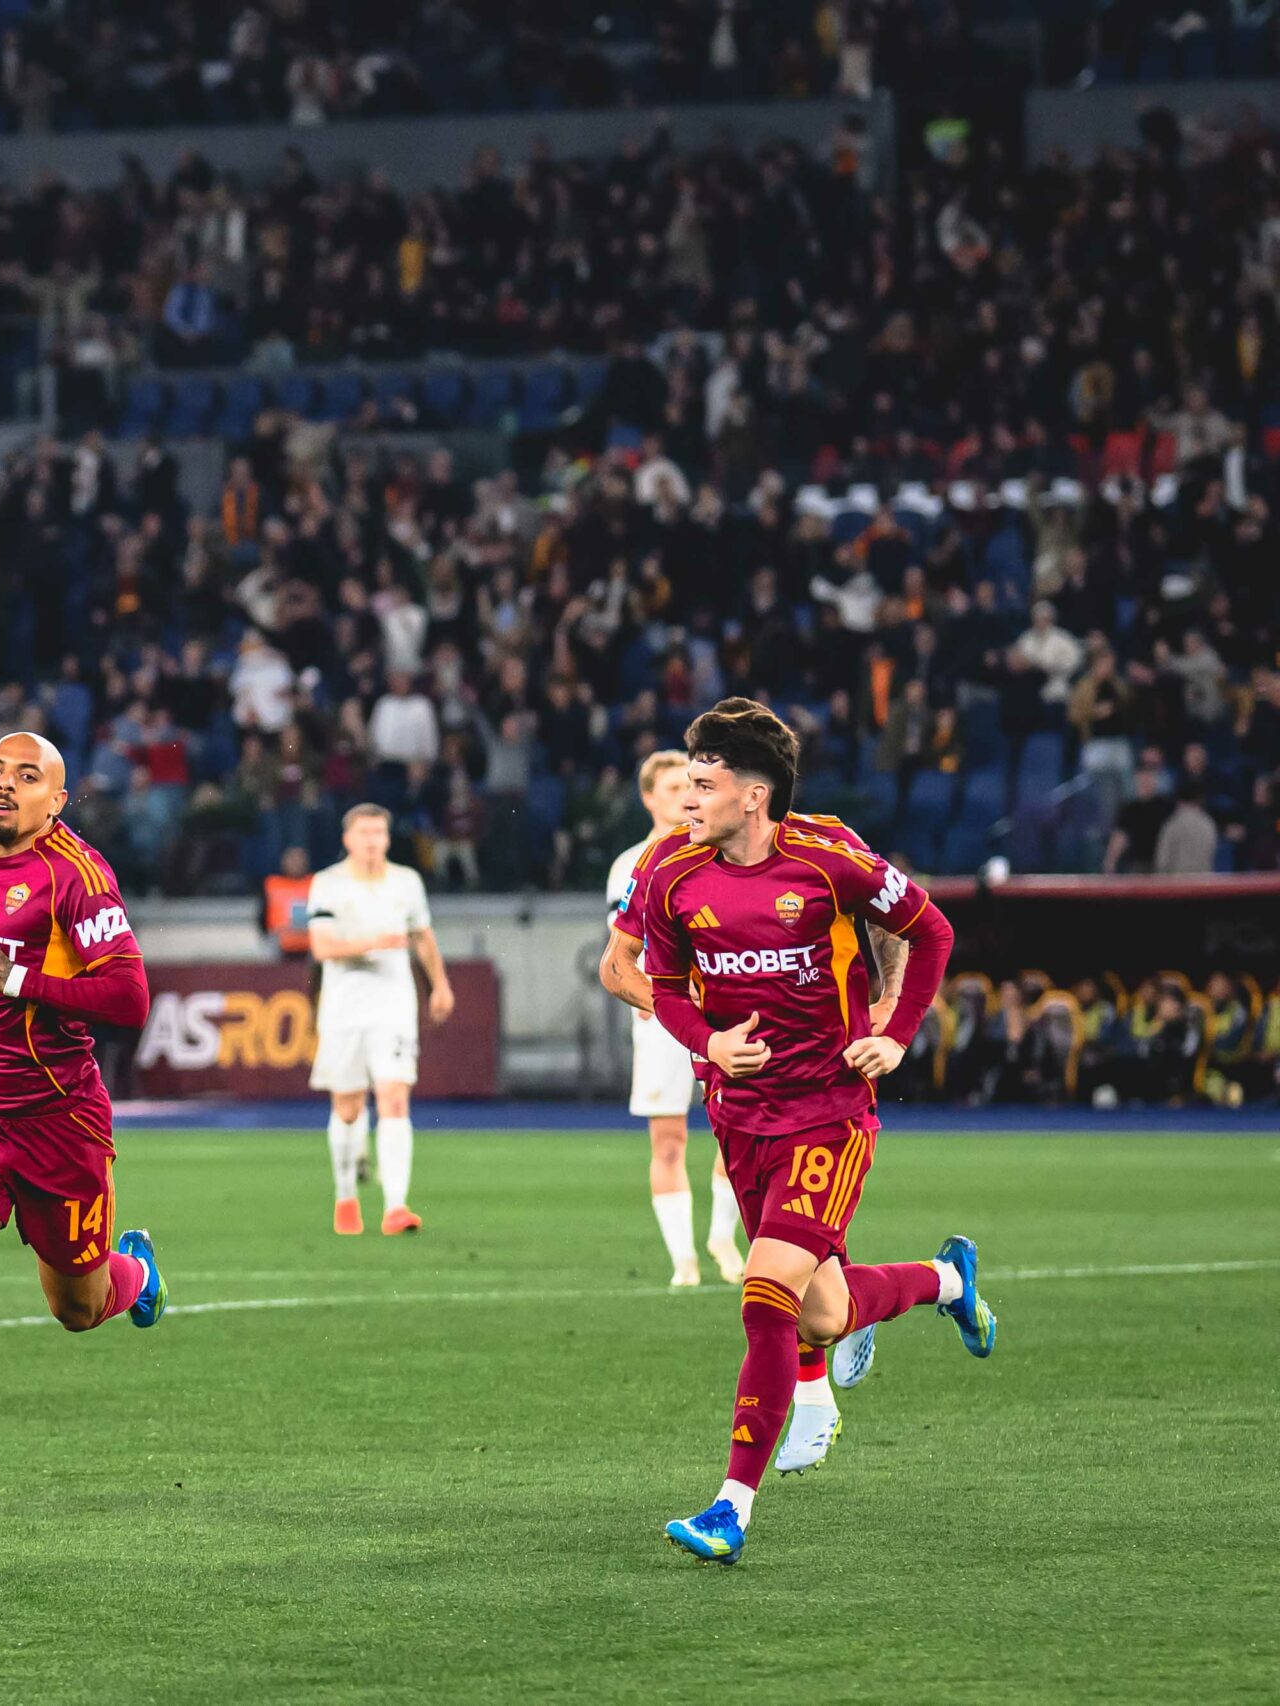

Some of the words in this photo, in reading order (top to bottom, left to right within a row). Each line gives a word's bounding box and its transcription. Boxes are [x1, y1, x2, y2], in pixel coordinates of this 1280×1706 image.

[695, 944, 816, 975] EUROBET
[787, 1145, 834, 1193] 18
[64, 1193, 104, 1241] 14
